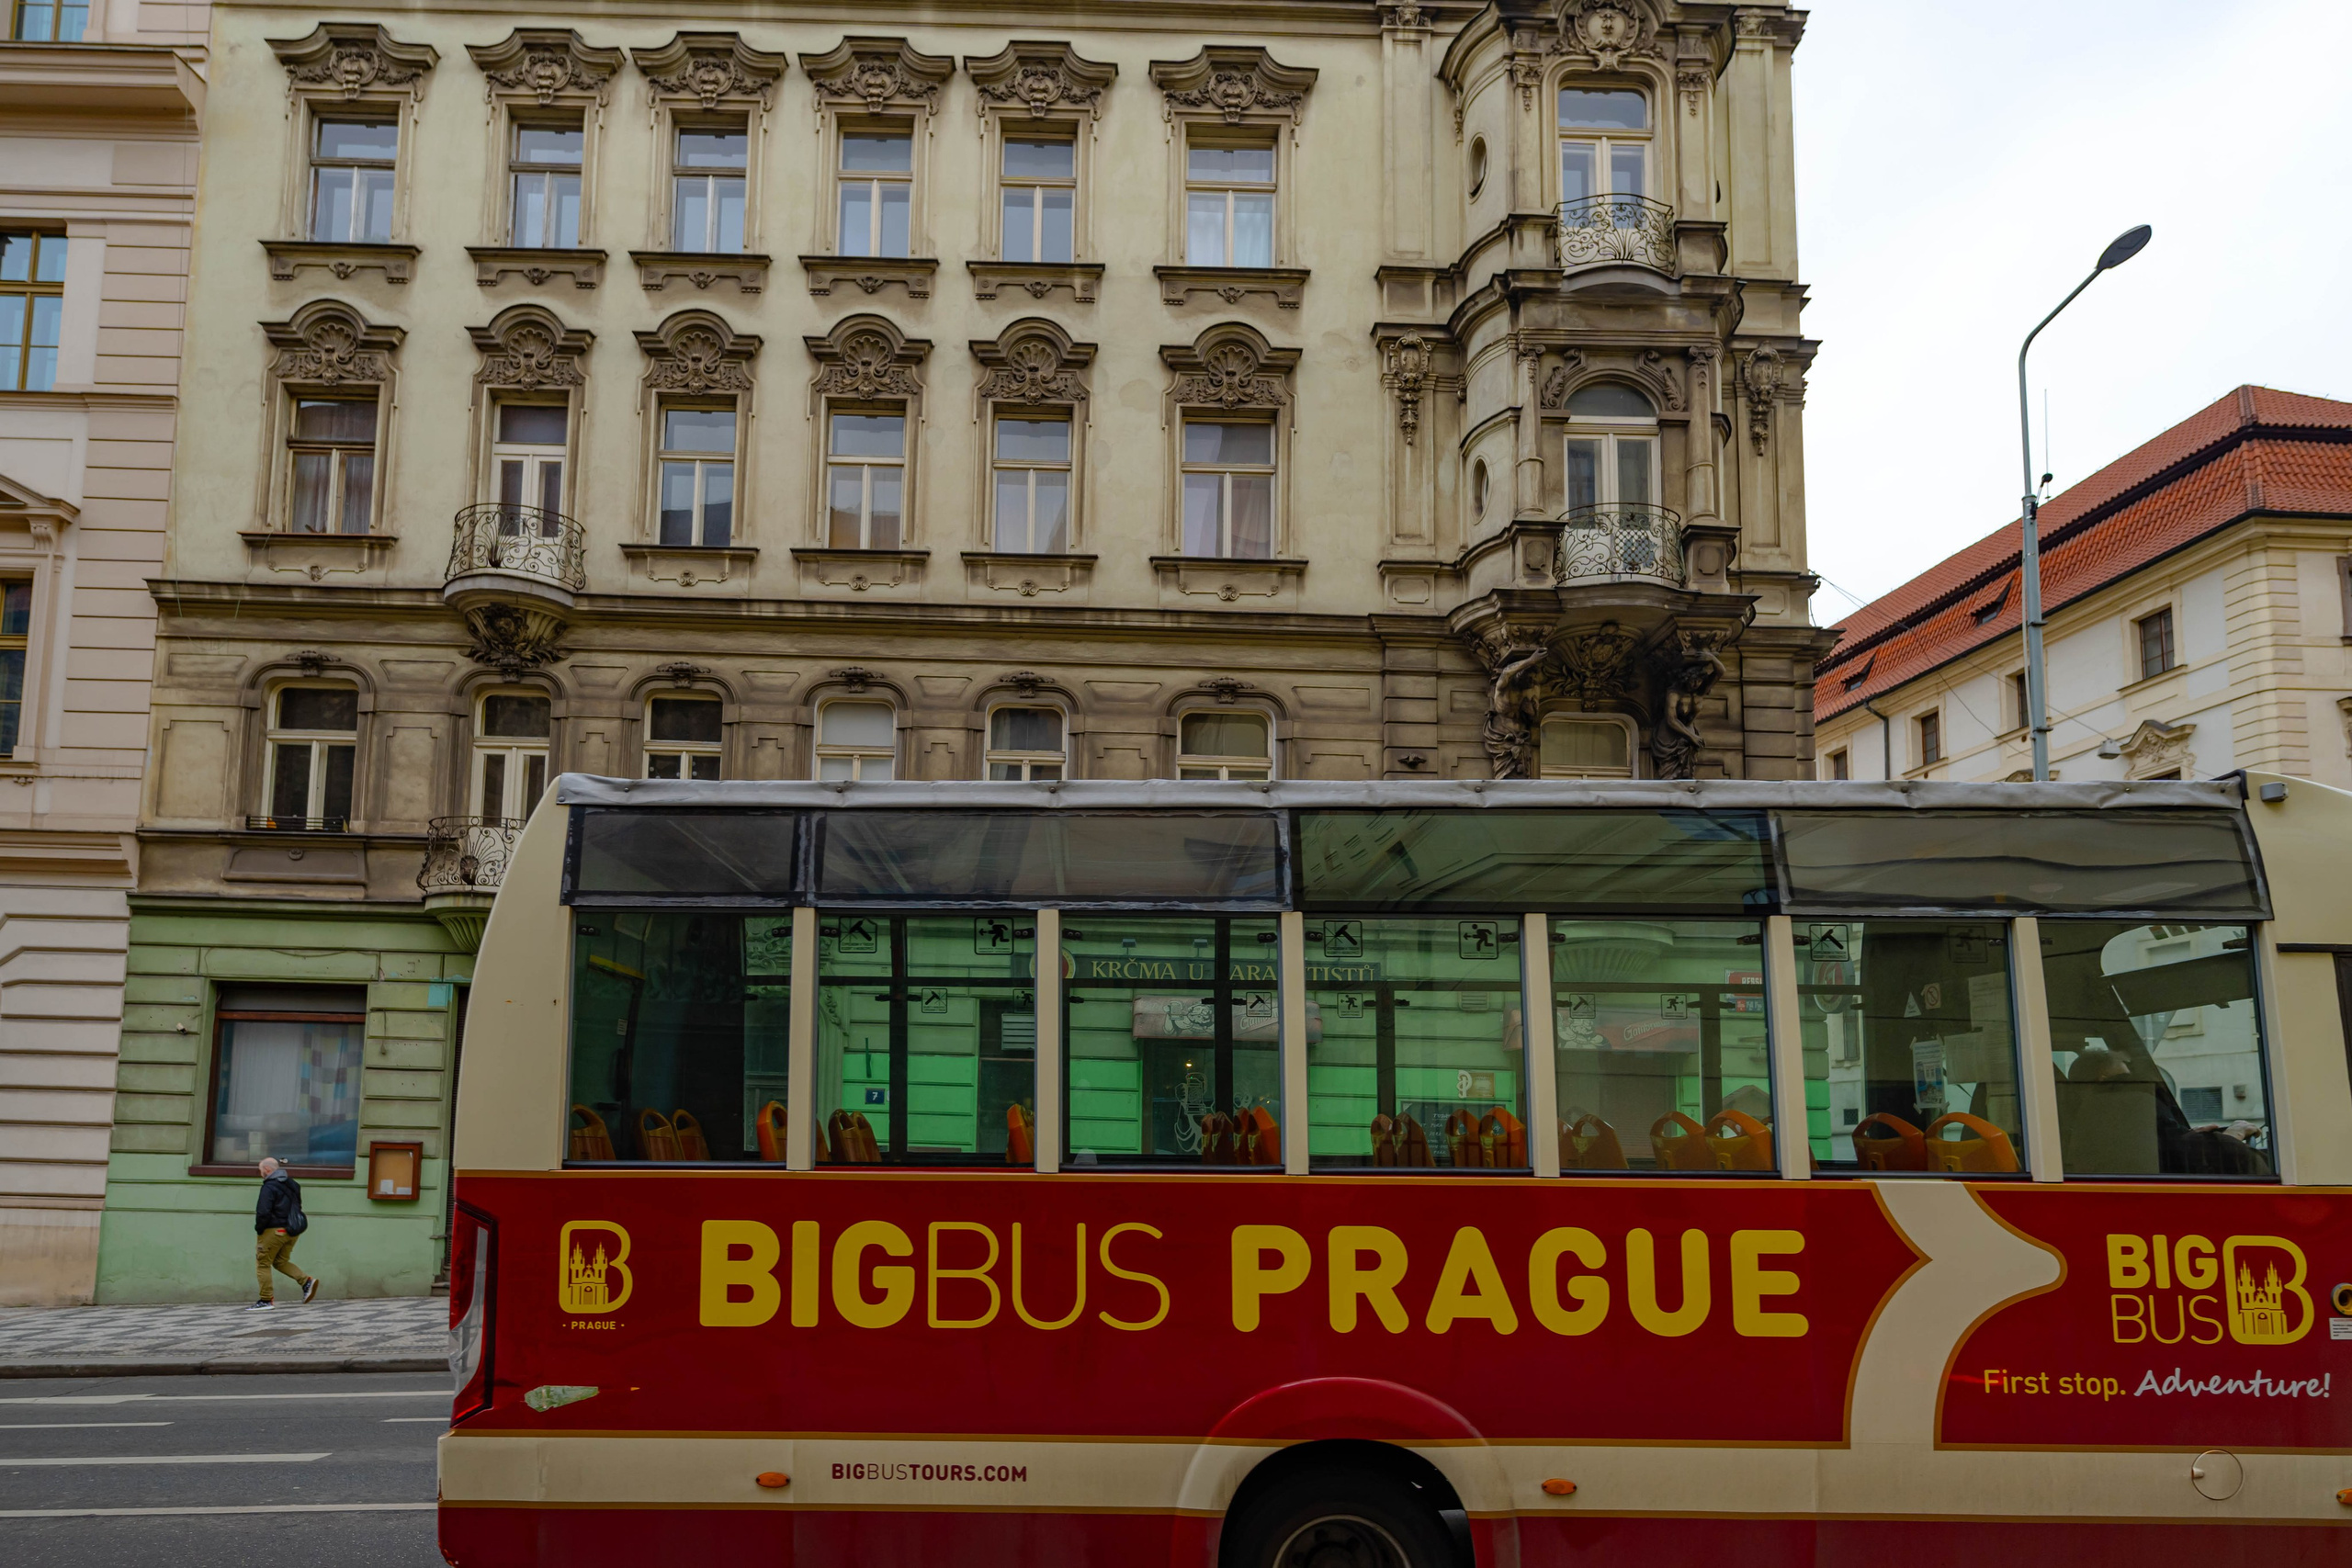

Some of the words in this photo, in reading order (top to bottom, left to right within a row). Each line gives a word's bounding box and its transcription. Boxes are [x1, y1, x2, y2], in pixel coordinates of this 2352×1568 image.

[1091, 958, 1176, 979] KRČMA
[1188, 964, 1204, 980] U
[872, 1091, 878, 1101] 7
[2106, 1234, 2219, 1291] BIG
[1230, 1224, 1810, 1337] PRAGUE
[571, 1320, 616, 1330] PRAGUE
[2110, 1293, 2223, 1345] BUS
[1984, 1369, 2051, 1394] First
[2058, 1372, 2126, 1402] stop.
[2133, 1367, 2331, 1398] Adventure!
[831, 1462, 1027, 1483] BIGBUSTOURS.COM
